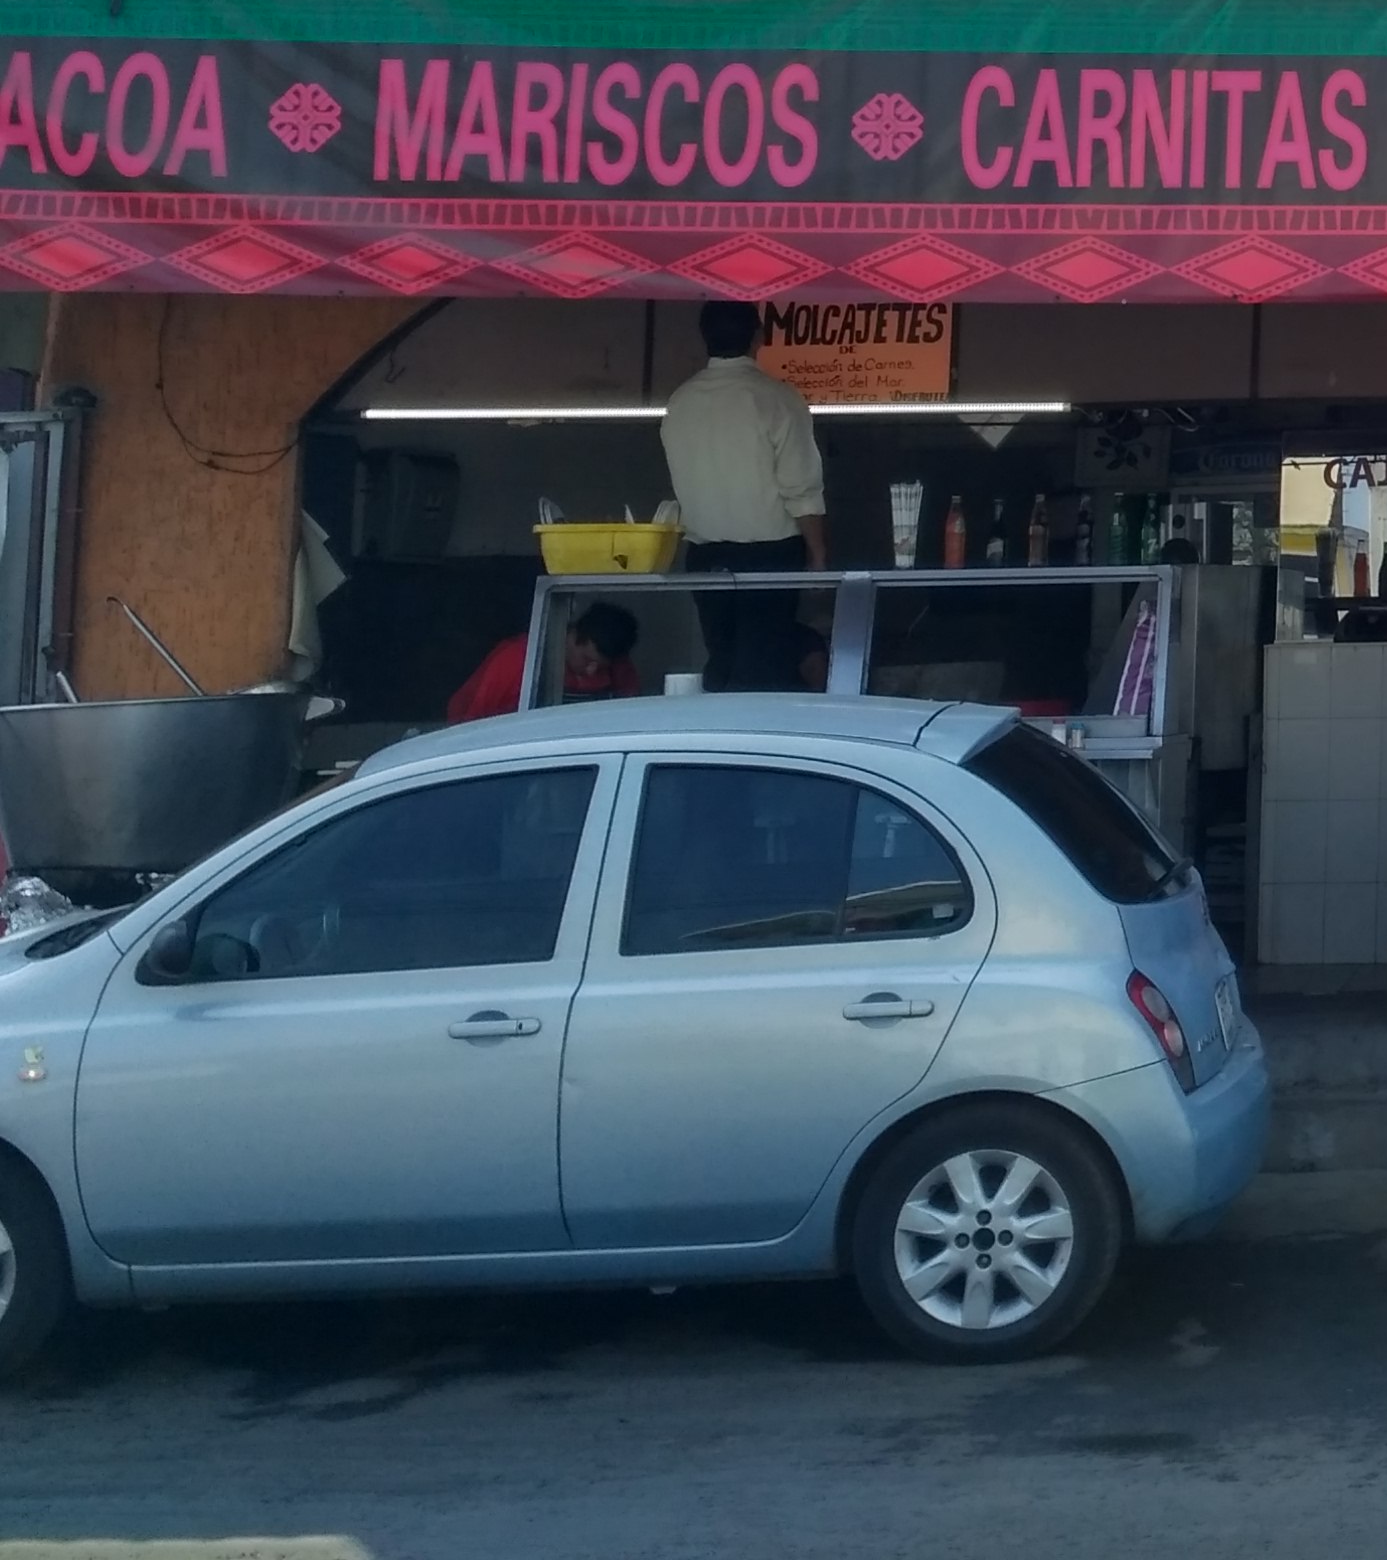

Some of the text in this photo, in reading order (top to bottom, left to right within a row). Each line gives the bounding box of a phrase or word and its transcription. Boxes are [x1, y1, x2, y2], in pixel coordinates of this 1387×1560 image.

[374, 59, 820, 188] MARISCOS
[960, 65, 1368, 191] CARNITAS
[764, 301, 947, 346] MOLCAJETES
[839, 346, 857, 354] DE
[788, 359, 843, 374] Selección
[848, 359, 862, 372] de
[850, 375, 868, 388] del
